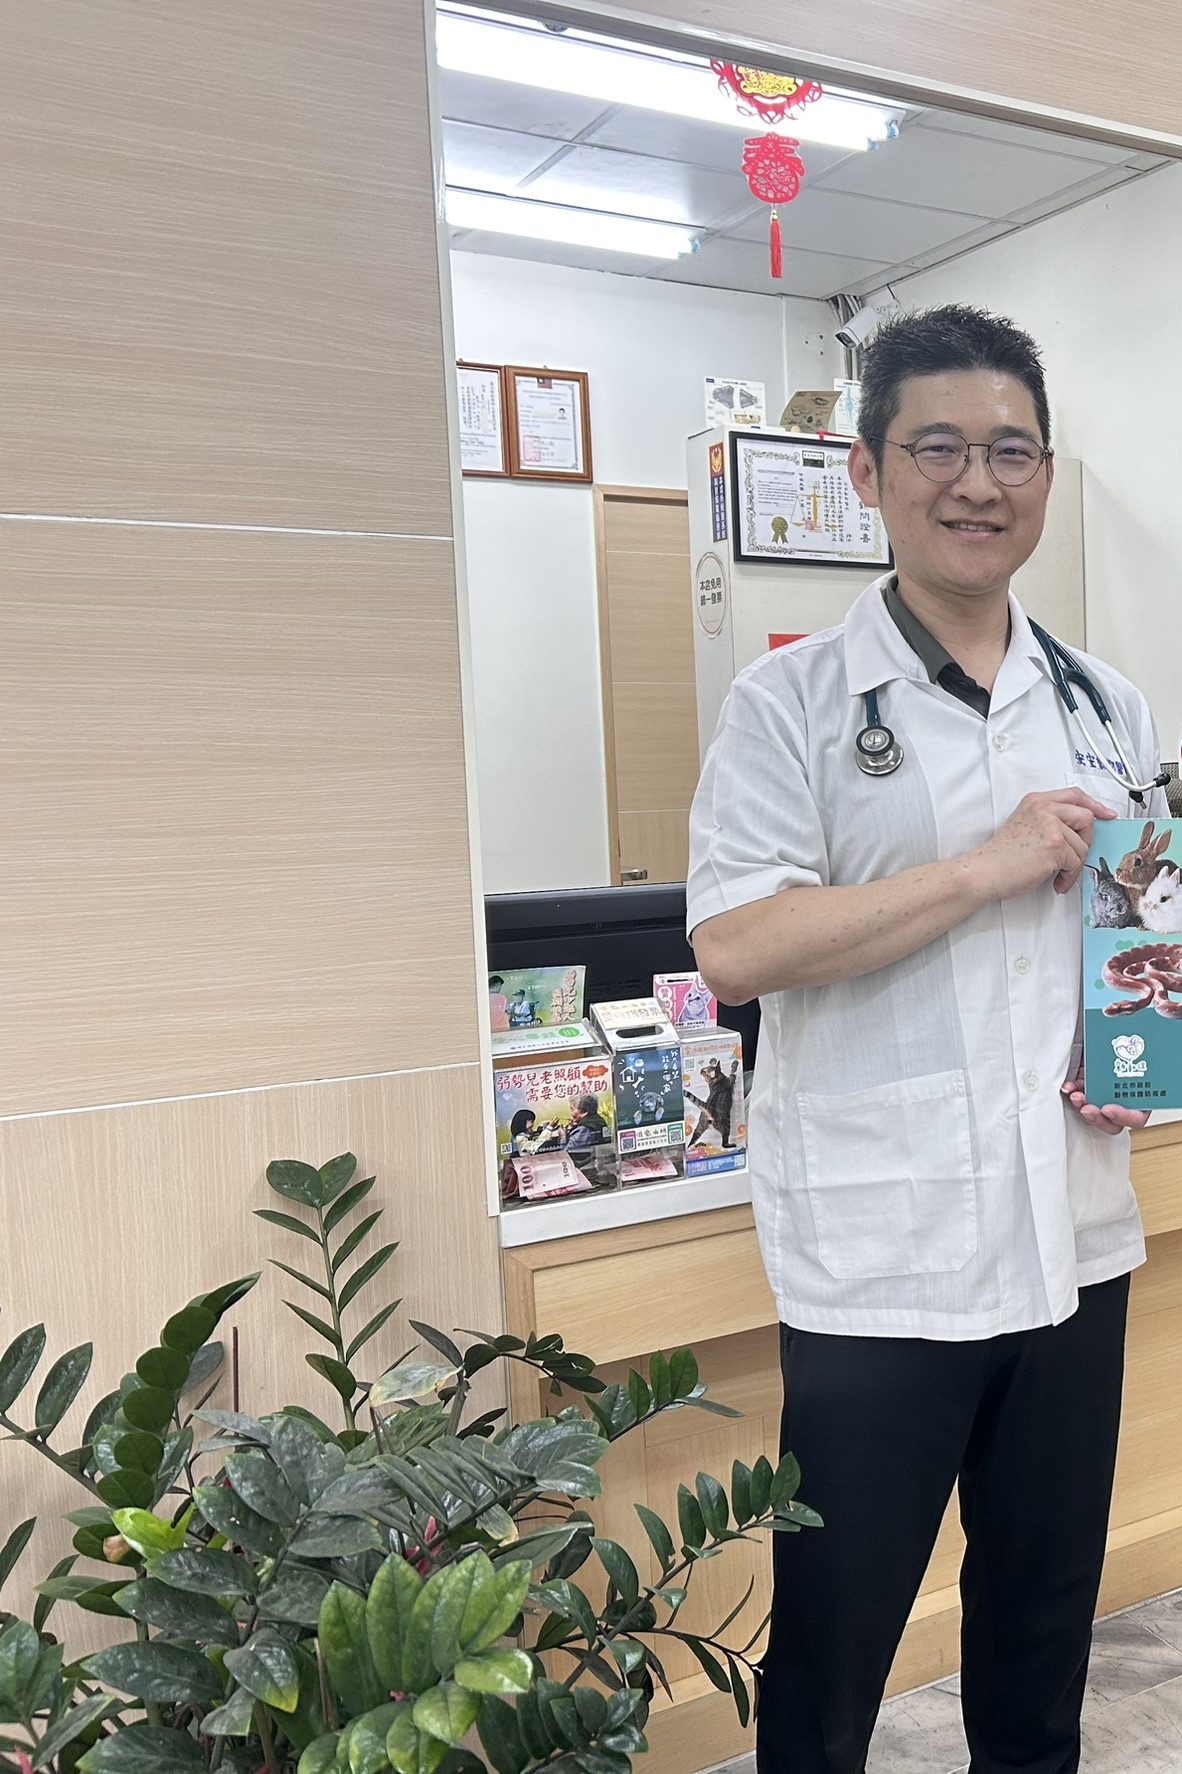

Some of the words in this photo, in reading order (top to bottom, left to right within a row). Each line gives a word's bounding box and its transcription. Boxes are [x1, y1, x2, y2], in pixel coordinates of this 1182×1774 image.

[700, 577, 722, 592] 本店免用
[700, 591, 722, 606] 統一發票
[497, 1067, 581, 1091] 弱勢兒老照顧
[526, 1080, 607, 1102] 需要您的幫助
[520, 1166, 534, 1191] 100
